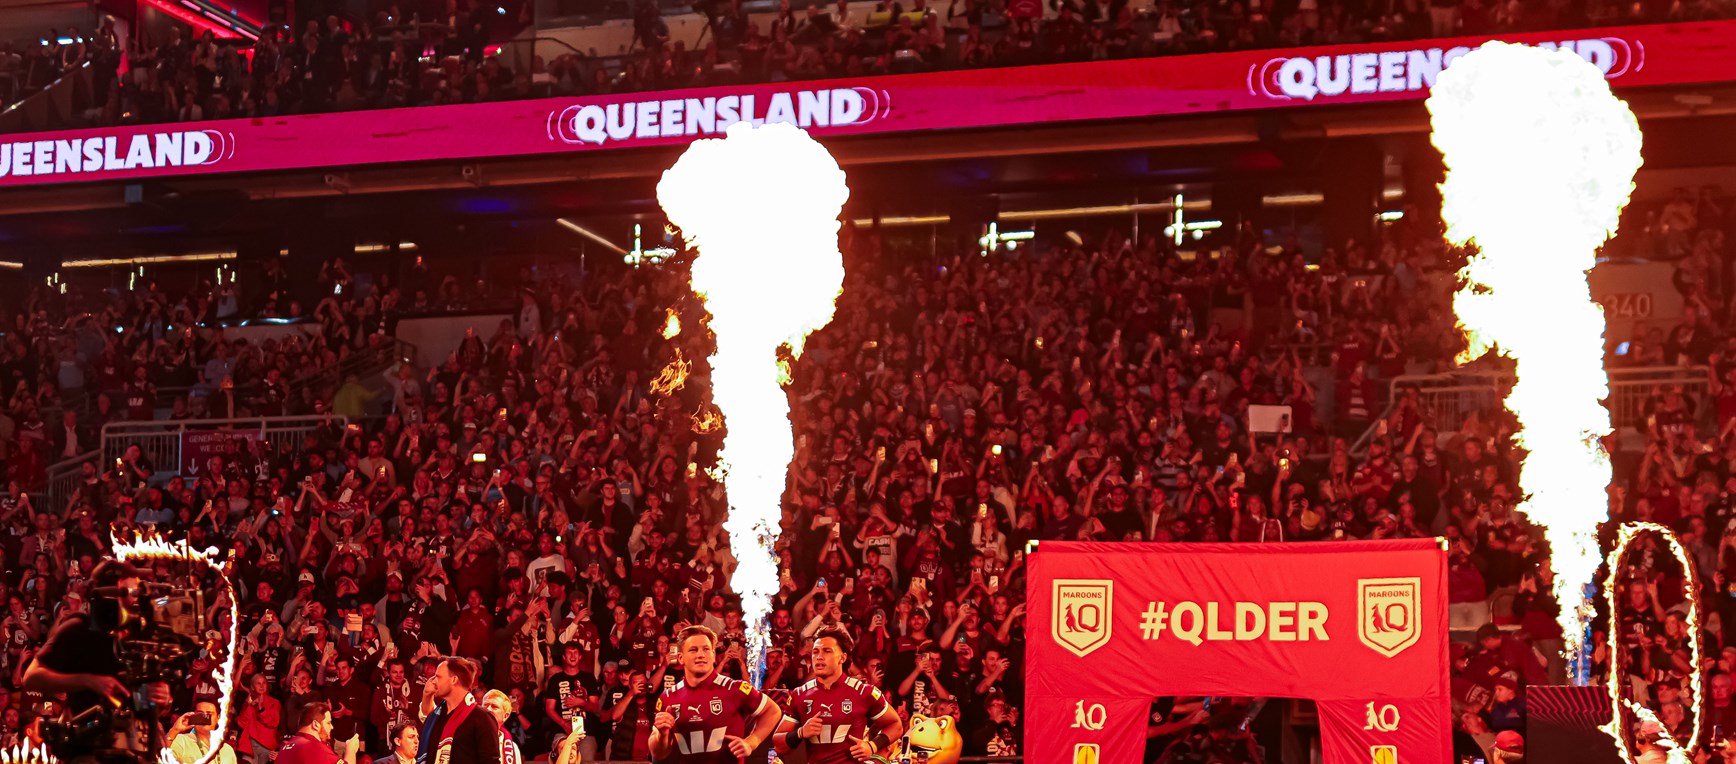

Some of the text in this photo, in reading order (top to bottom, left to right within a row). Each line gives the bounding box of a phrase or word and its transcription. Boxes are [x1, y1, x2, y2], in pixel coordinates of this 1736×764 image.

[1278, 39, 1613, 100] QUEEND
[574, 88, 863, 145] QUEENSLAND
[1604, 294, 1650, 318] 340
[1140, 601, 1330, 646] #QLDER
